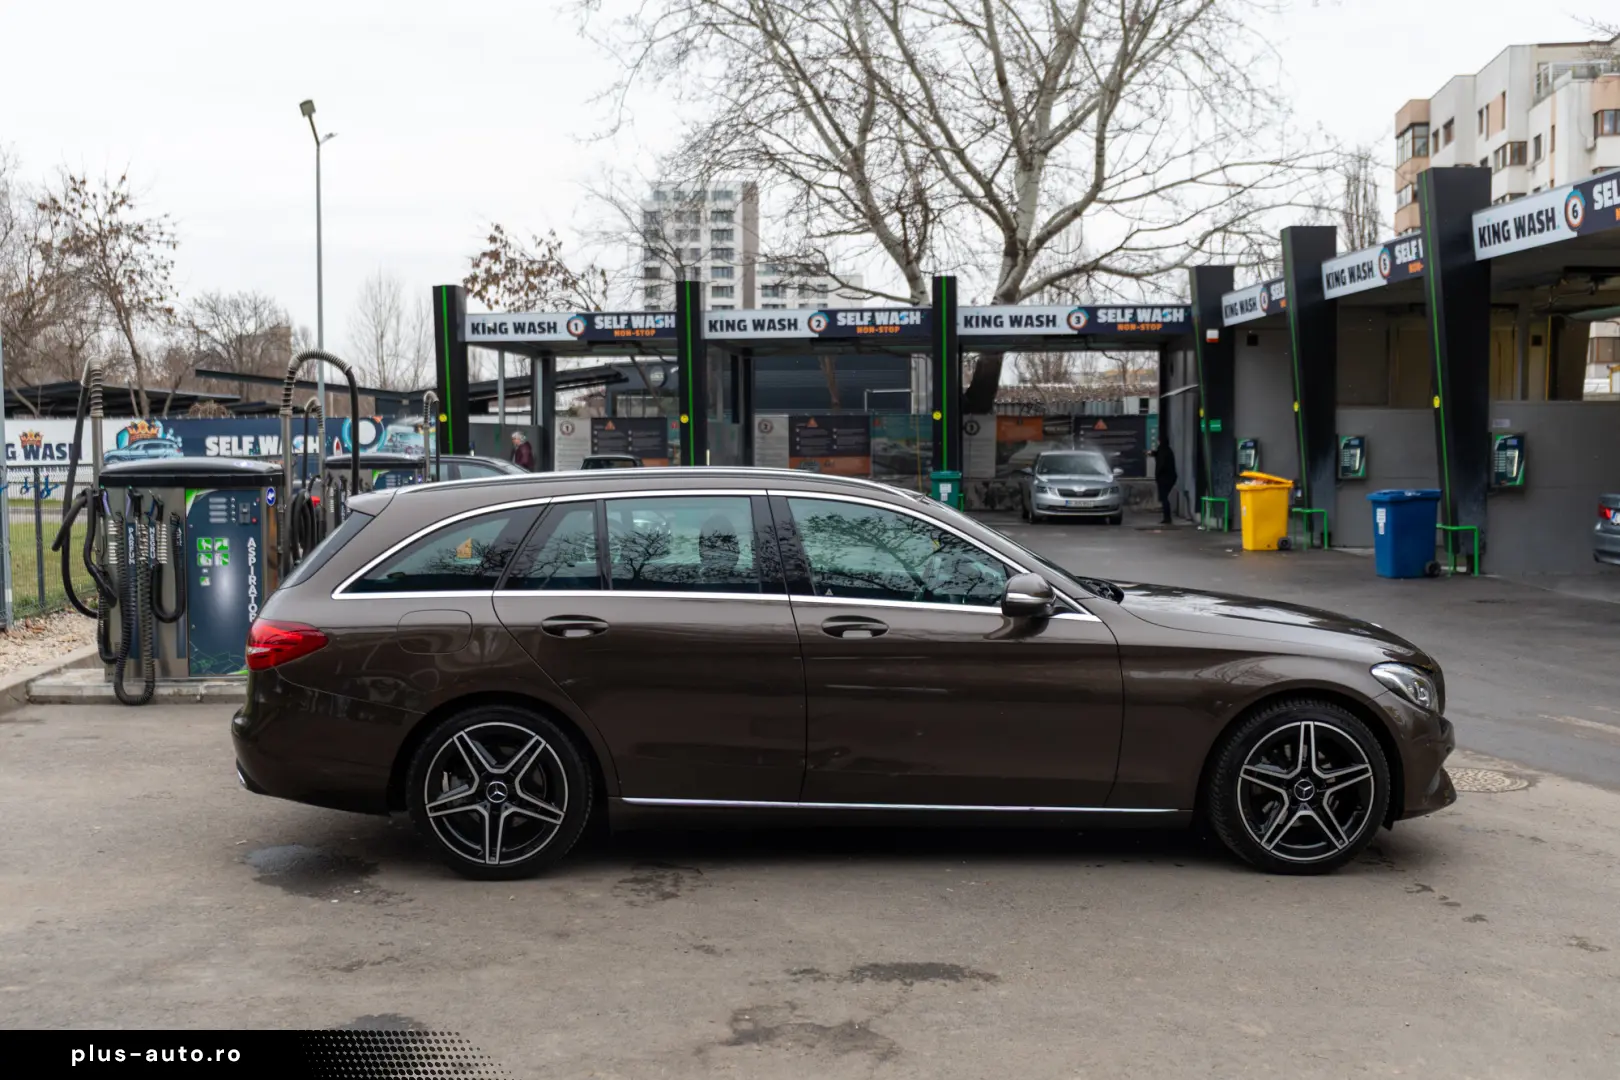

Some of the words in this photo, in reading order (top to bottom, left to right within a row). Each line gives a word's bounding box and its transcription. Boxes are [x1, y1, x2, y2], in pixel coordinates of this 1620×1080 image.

[1592, 179, 1620, 210] SEL
[1571, 203, 1579, 220] 6
[1478, 220, 1511, 249] KING
[1513, 207, 1556, 240] WASH
[1394, 240, 1418, 265] SELF
[1325, 268, 1346, 291] KING
[1347, 260, 1374, 284] WASH
[1239, 296, 1258, 316] WASH
[594, 315, 628, 330] SELF
[628, 314, 676, 329] WASH
[836, 312, 872, 326] SELF
[874, 311, 921, 325] WASH
[963, 315, 1010, 329] KING
[1014, 314, 1057, 328] WASH
[1074, 316, 1081, 325] 3
[1096, 309, 1133, 323] SELF
[1136, 308, 1185, 322] WASH
[471, 321, 508, 336] KING
[513, 321, 558, 335] WASH
[574, 322, 580, 332] 1
[708, 318, 748, 333] KING
[752, 318, 799, 331] WASH
[815, 319, 822, 328] 2
[856, 326, 900, 334] NON-STOP
[1116, 323, 1163, 331] NON-STOP
[613, 329, 656, 337] NON-STOP
[205, 435, 254, 456] SELF
[127, 526, 136, 565] PARFUM
